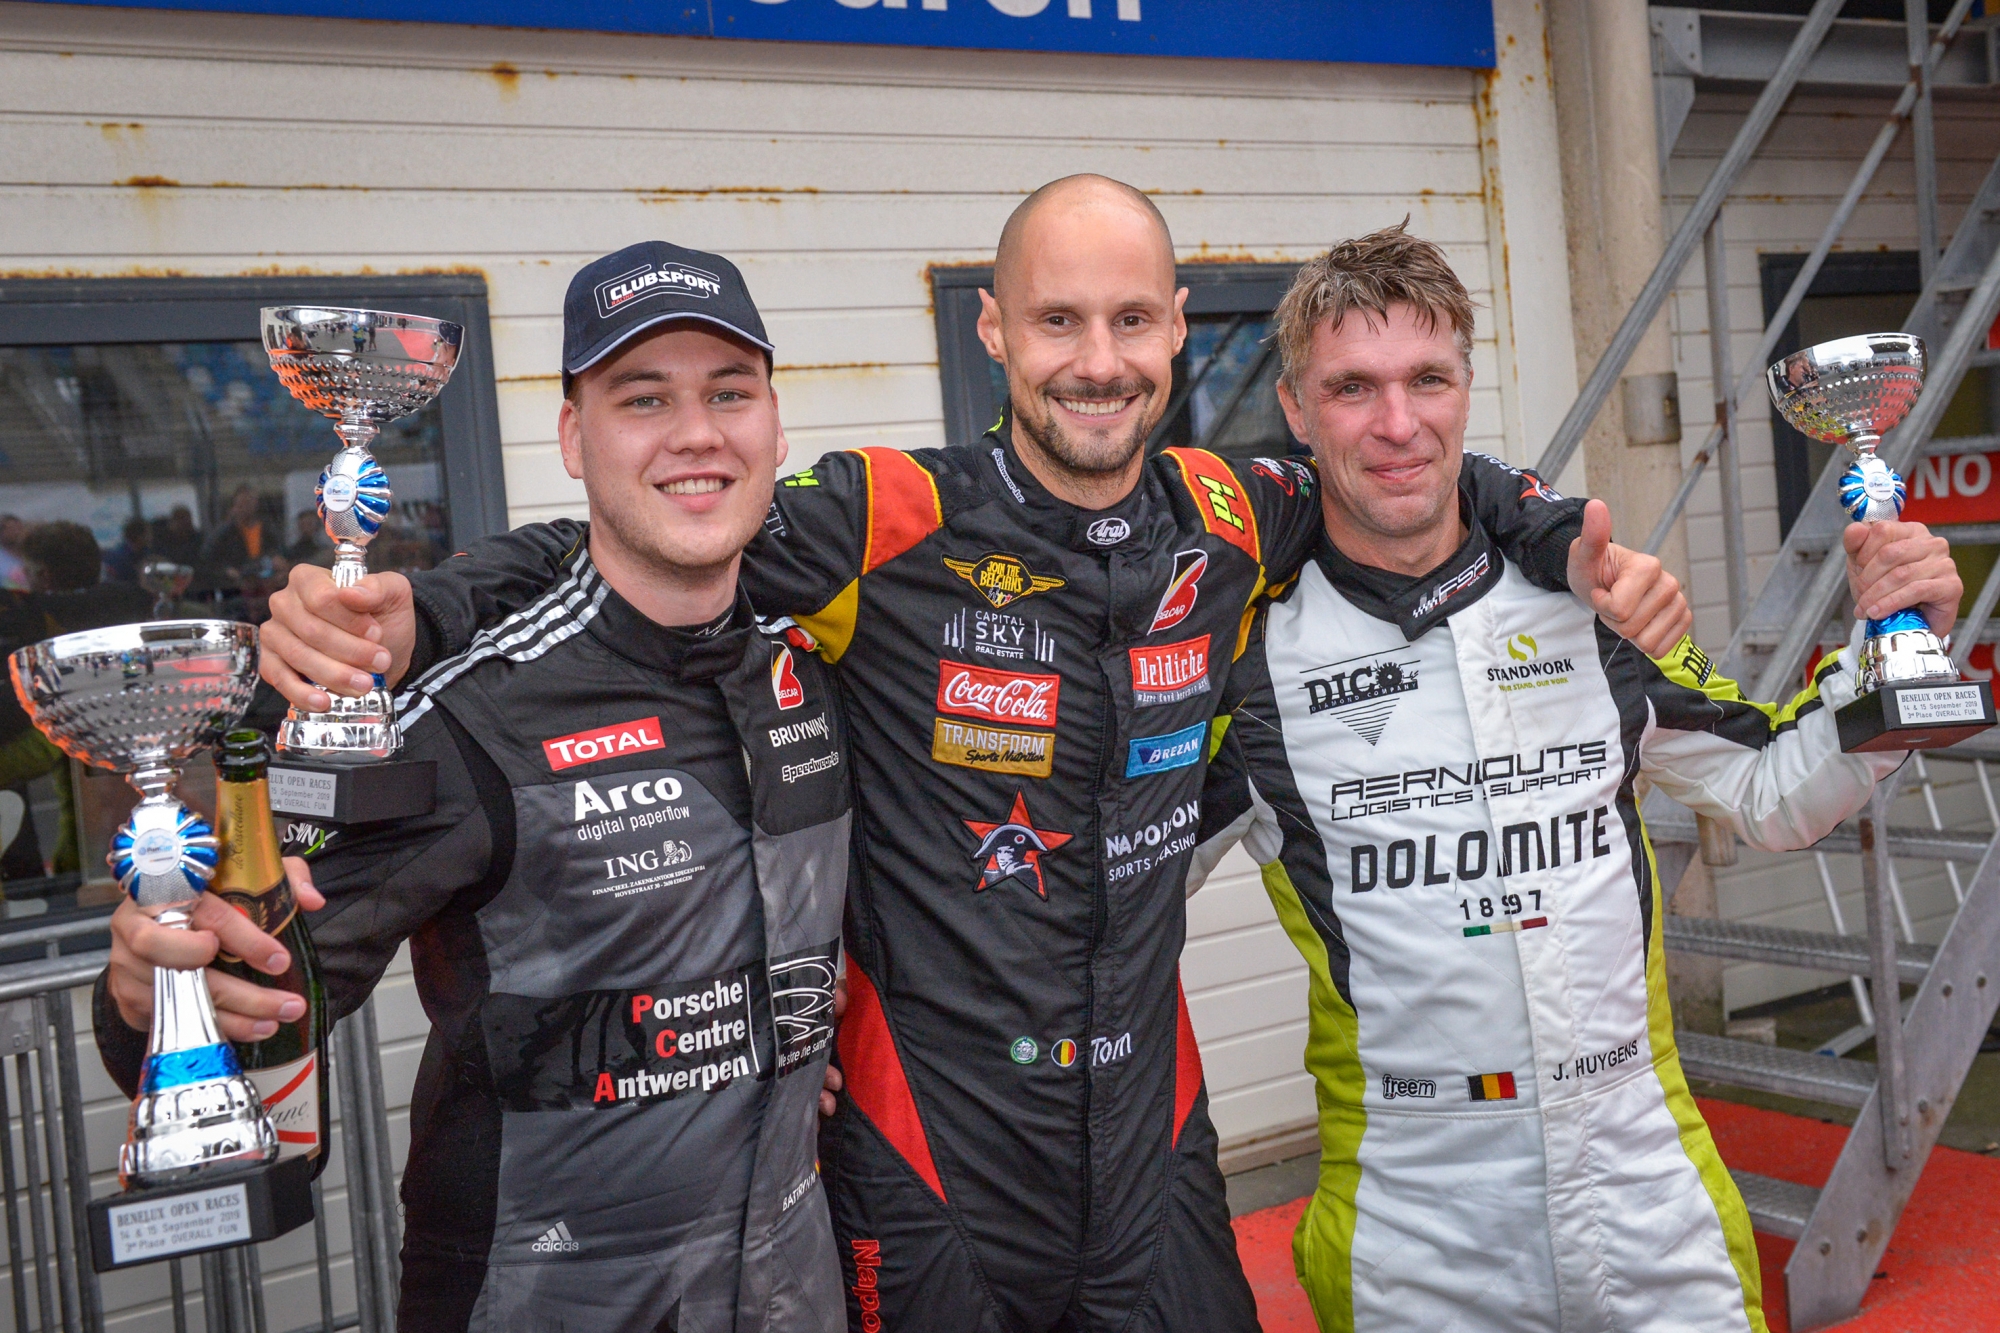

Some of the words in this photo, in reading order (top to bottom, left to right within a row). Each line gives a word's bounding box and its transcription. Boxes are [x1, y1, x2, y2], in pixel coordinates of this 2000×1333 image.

[609, 270, 721, 302] CLUBSPORT
[610, 293, 635, 306] RACING
[1914, 454, 1992, 500] NO
[1090, 520, 1125, 538] Arai
[979, 570, 1024, 594] BELGIANS
[986, 561, 1005, 577] JOIN
[1006, 565, 1021, 578] THE
[975, 610, 1025, 626] CAPITAL
[1157, 604, 1186, 623] BELCAR
[975, 621, 1025, 646] SKY
[975, 645, 995, 656] REAL
[996, 649, 1024, 660] ESTATE
[1136, 649, 1207, 687] Deldiche
[1487, 658, 1575, 682] STANDWORK
[777, 687, 799, 700] BELCAR
[1550, 676, 1569, 686] WORK
[944, 671, 1054, 719] Coca-Cola
[1311, 695, 1360, 712] DIAMOND
[1366, 682, 1417, 698] COMPANY
[1900, 693, 1931, 703] BENELUX
[1933, 692, 1952, 701] OPEN
[1955, 690, 1977, 700] RACES
[1930, 702, 1962, 711] September
[1916, 711, 1933, 719] Place
[1964, 708, 1977, 716] FUN
[768, 712, 830, 748] BRUYNINX
[943, 723, 1045, 756] TRANSFORM
[550, 729, 659, 763] TOTAL
[965, 749, 1000, 765] Sports
[1001, 750, 1046, 763] Nutrition
[1148, 738, 1199, 764] BREZAN
[287, 776, 306, 788] OPEN
[309, 778, 332, 790] RACES
[1331, 740, 1607, 805] AERNOUTS
[280, 788, 314, 800] September
[316, 793, 331, 801] 2019
[284, 799, 311, 810] OVERALL
[314, 802, 327, 811] FUN
[574, 777, 683, 822] Arco
[1331, 789, 1474, 822] LOGISTICS
[1484, 766, 1607, 800] SUPPORT
[577, 816, 625, 841] digital
[629, 805, 691, 832] paperflow
[1350, 804, 1612, 894] DOLOMITE
[603, 848, 660, 880] ING
[1108, 857, 1151, 882] SPORTS
[1459, 889, 1542, 921] 1897
[631, 979, 743, 1024] Porsche
[655, 1018, 746, 1059] Centre
[1552, 1063, 1570, 1081] J.
[1575, 1039, 1638, 1078] HUYGENS
[593, 1055, 750, 1103] Antwerpen
[1382, 1073, 1437, 1099] freem
[117, 1208, 165, 1228] BENELUX
[170, 1201, 200, 1217] OPEN
[205, 1192, 240, 1211] RACES
[148, 1226, 157, 1235] 15
[162, 1215, 215, 1234] September
[171, 1228, 213, 1243] OVERALL
[217, 1223, 238, 1235] FUN
[531, 1240, 580, 1252] adidas
